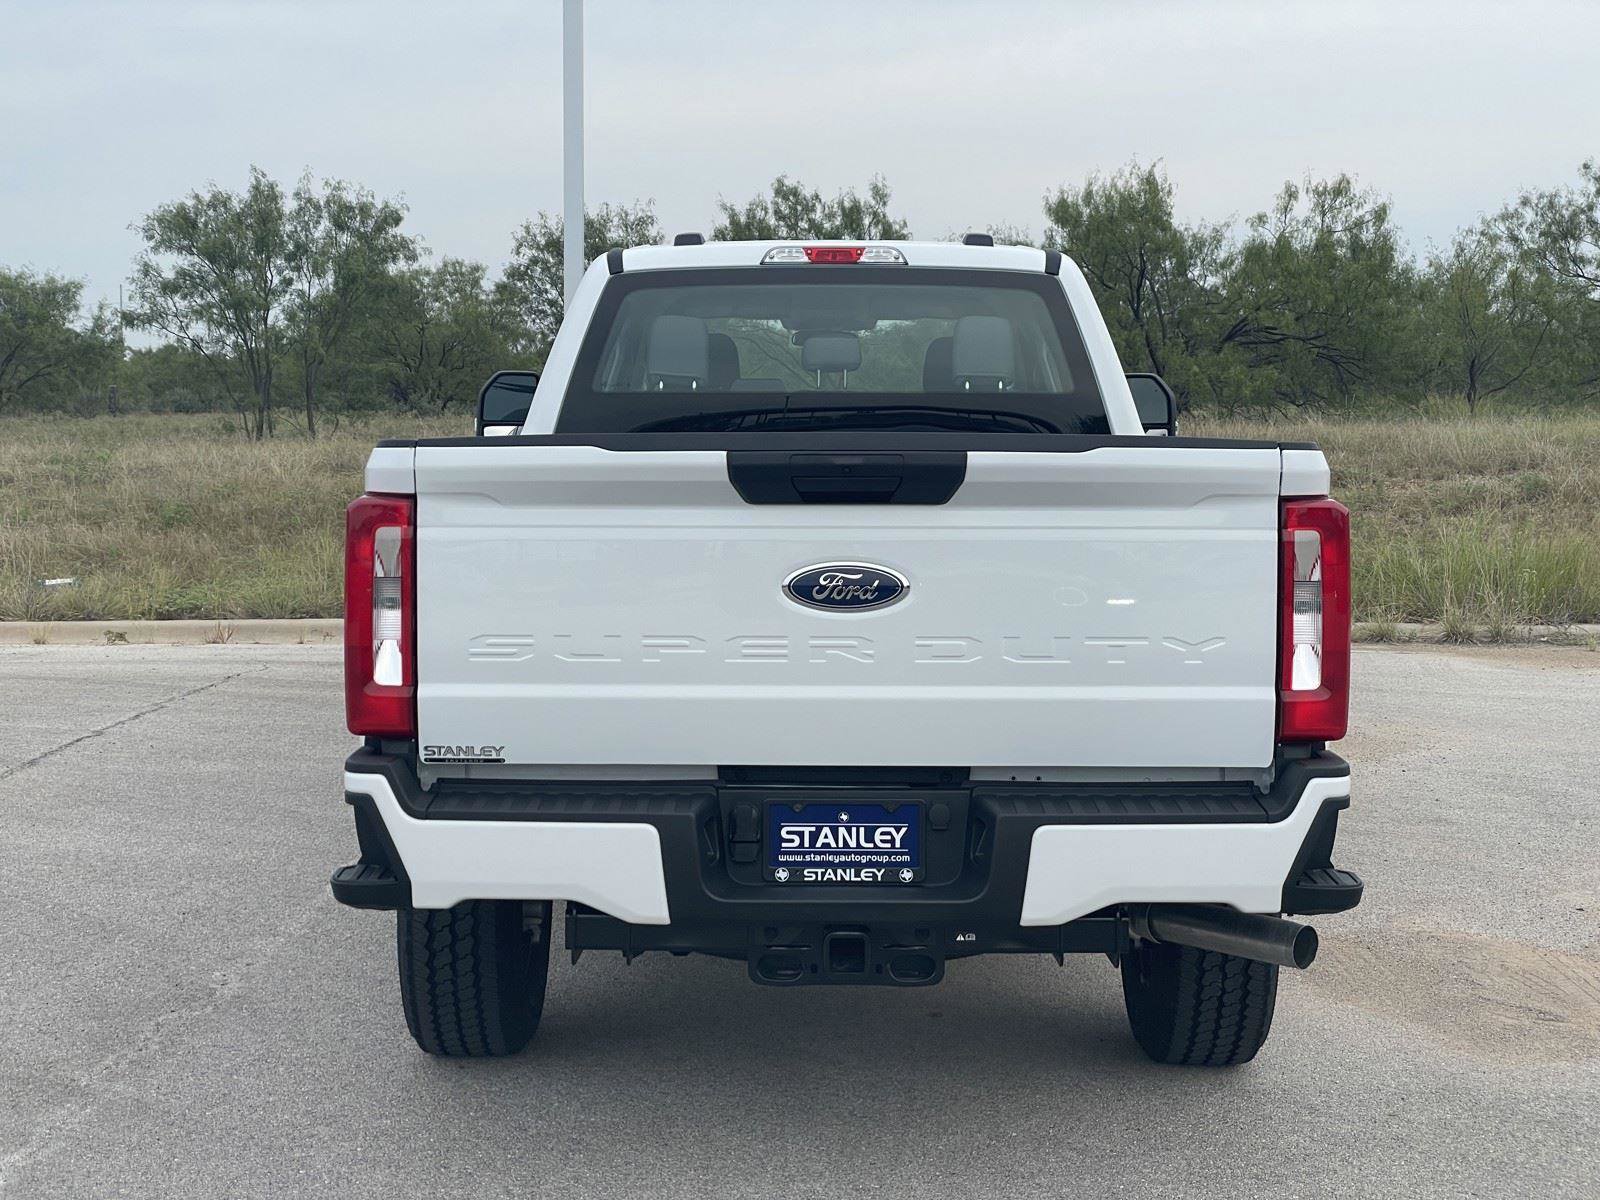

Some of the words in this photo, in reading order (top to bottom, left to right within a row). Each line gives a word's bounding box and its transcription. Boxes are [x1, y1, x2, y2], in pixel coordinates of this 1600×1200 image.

[812, 572, 880, 601] Ford
[468, 634, 875, 663] SUPER
[914, 636, 1226, 664] DUTY
[423, 745, 505, 757] STANLEY
[780, 826, 908, 848] STANLEY
[778, 853, 911, 863] www.stanleyautogroup.com
[803, 868, 885, 881] STANLEY
